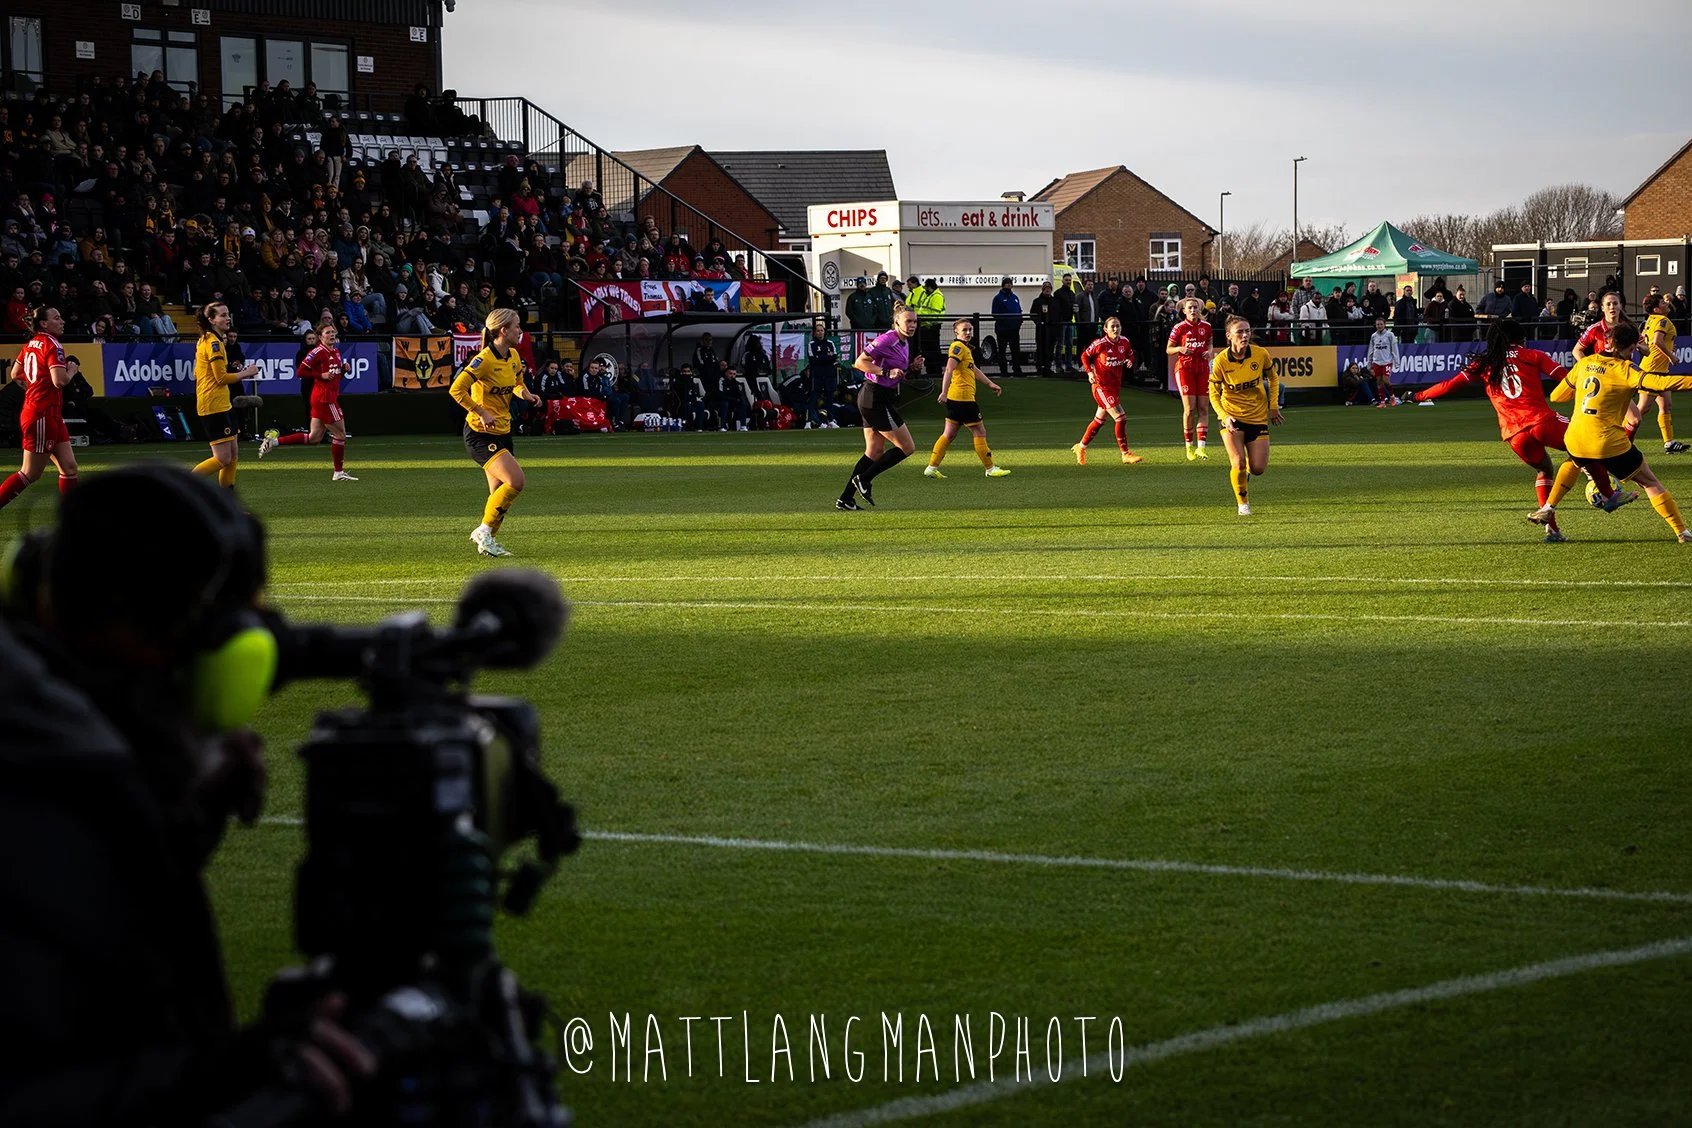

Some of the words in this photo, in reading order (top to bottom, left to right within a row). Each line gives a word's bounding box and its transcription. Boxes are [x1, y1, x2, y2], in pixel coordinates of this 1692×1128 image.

[133, 9, 139, 19] D
[194, 13, 200, 23] E
[419, 31, 425, 41] E
[827, 208, 878, 228] CHIPS
[961, 209, 985, 227] eat
[988, 211, 998, 227] &
[1001, 206, 1040, 227] drink
[948, 276, 972, 284] FRESHLY
[975, 276, 999, 284] COOKED
[23, 351, 38, 384] 10
[114, 359, 173, 382] Adobe
[343, 358, 369, 380] UP
[1447, 354, 1462, 372] FA
[1501, 363, 1522, 399] 6
[1582, 375, 1602, 416] 2
